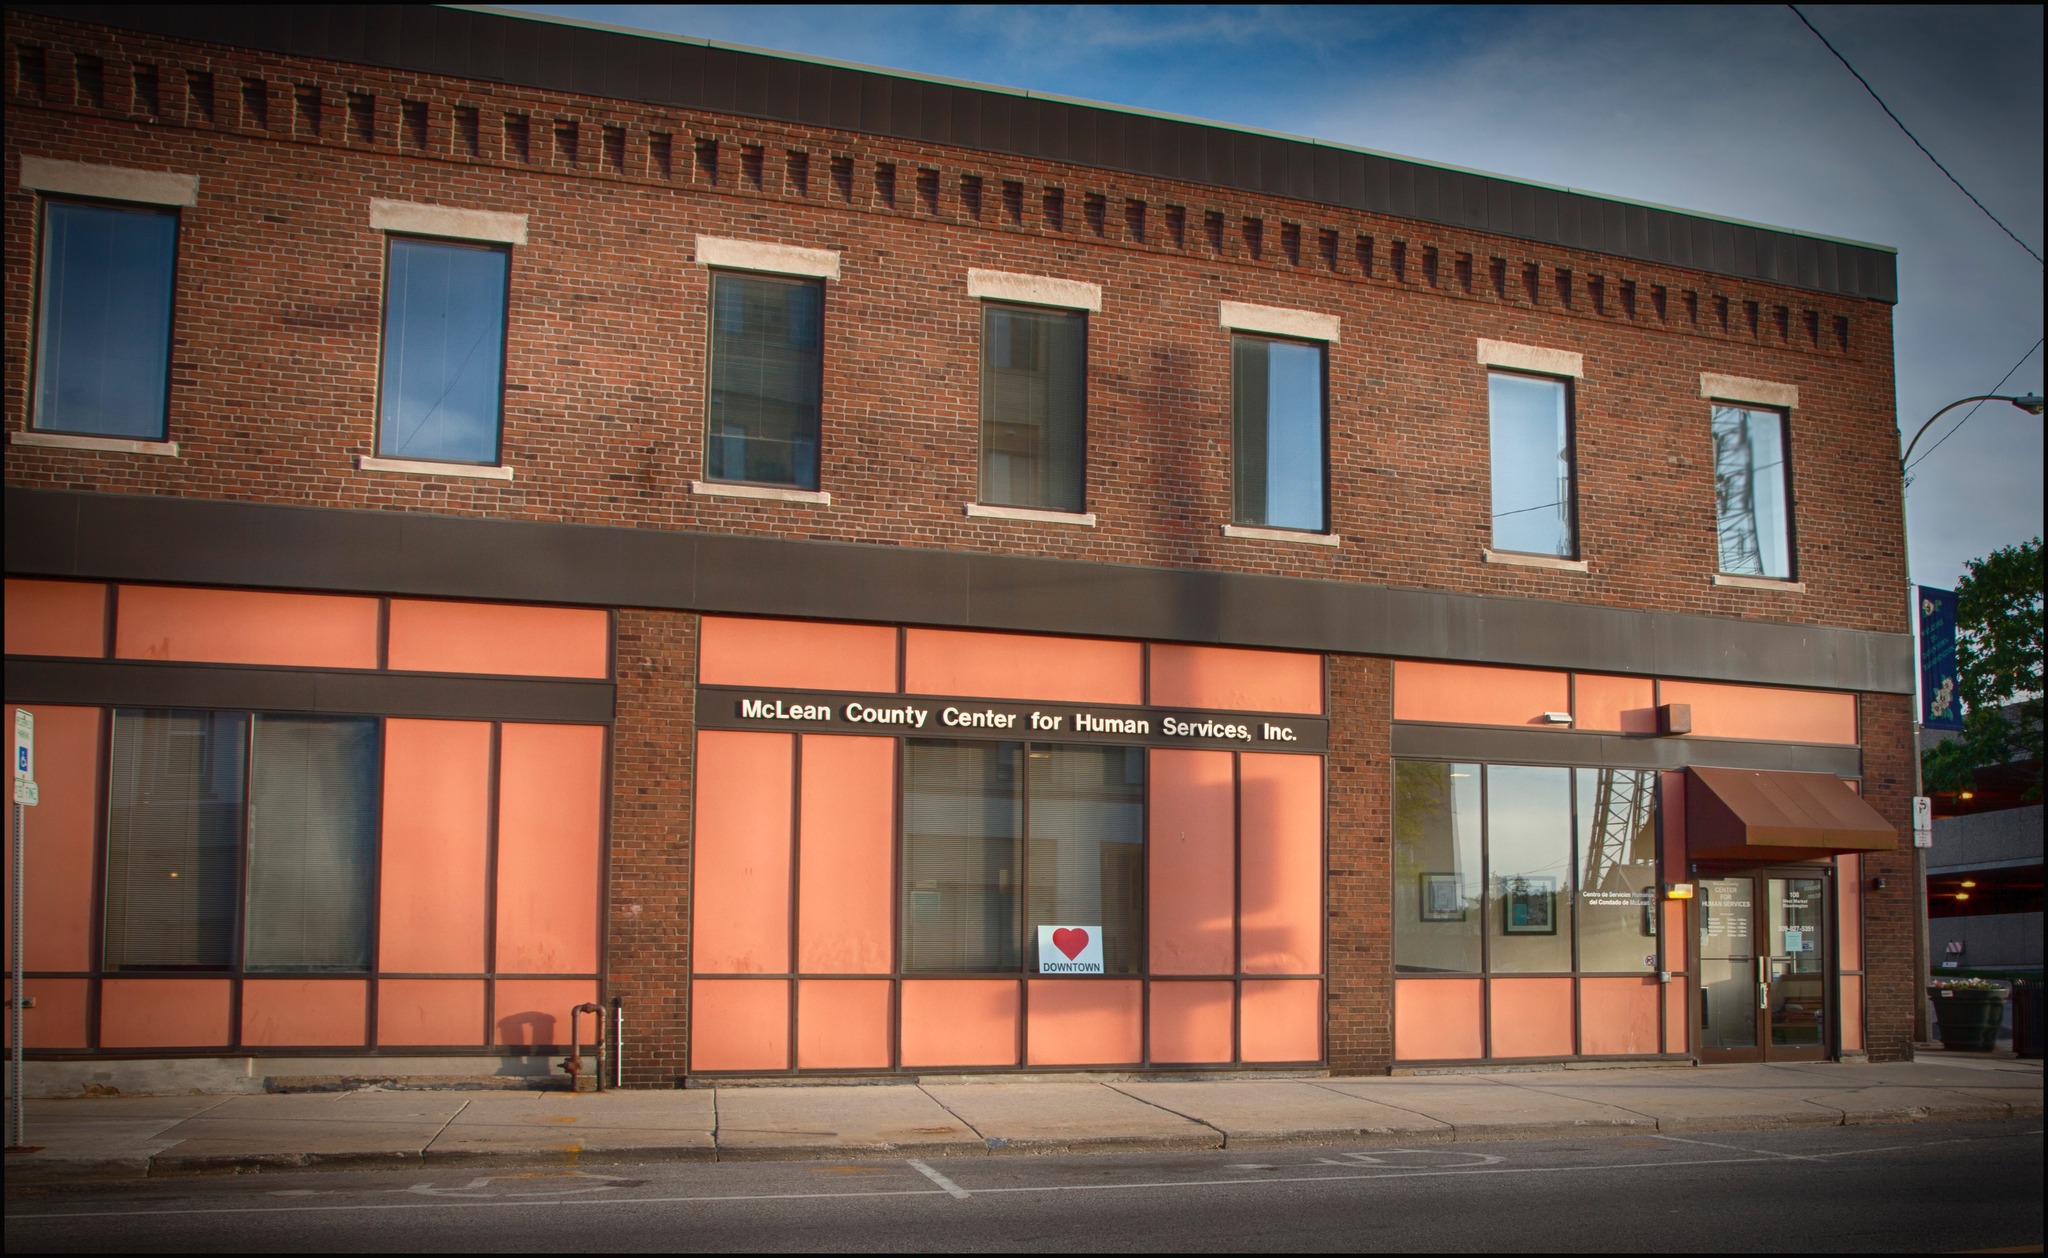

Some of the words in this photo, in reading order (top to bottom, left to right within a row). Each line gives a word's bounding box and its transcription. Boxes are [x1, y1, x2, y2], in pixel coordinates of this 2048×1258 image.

[742, 699, 831, 720] McLean
[846, 702, 928, 728] County
[942, 707, 1016, 728] Center
[1030, 711, 1062, 730] for
[1075, 714, 1150, 734] Human
[1162, 717, 1252, 741] Services,
[1263, 723, 1297, 741] Inc.
[1043, 962, 1101, 972] DOWNTOWN
